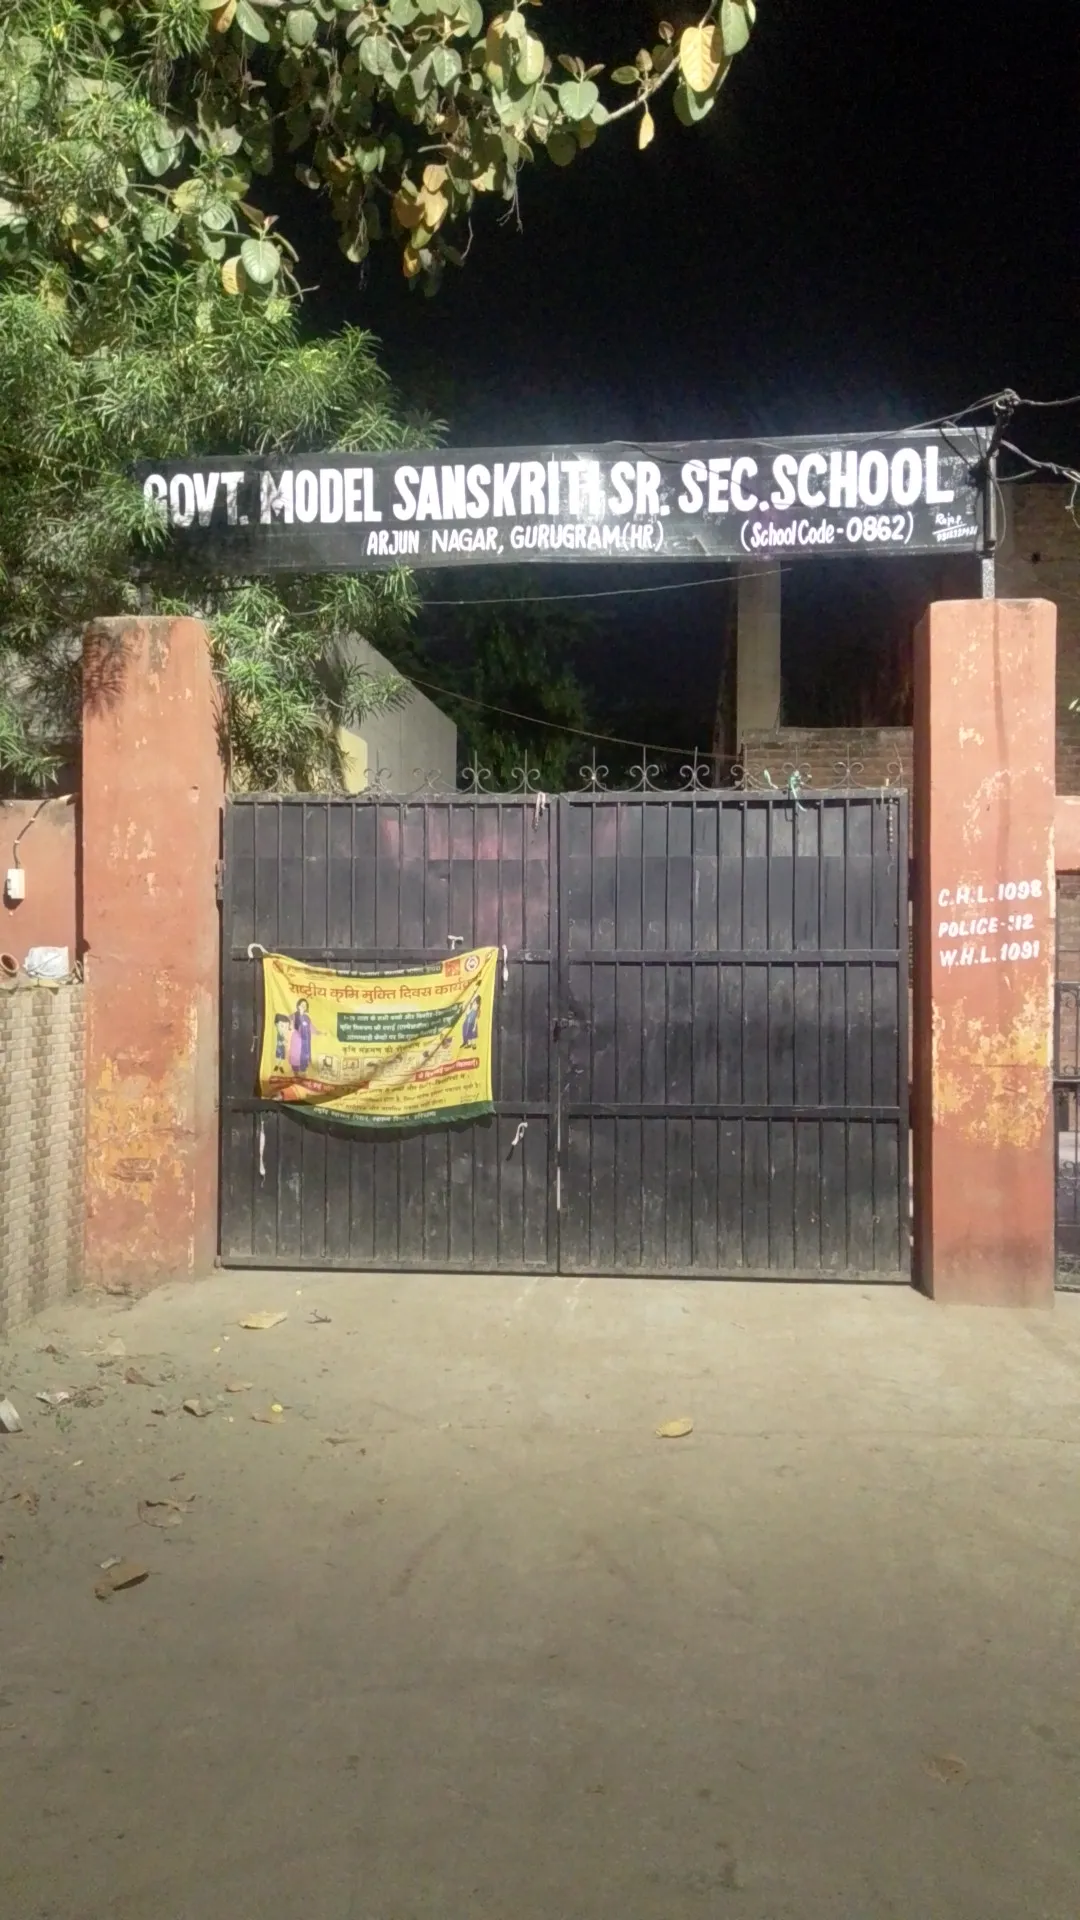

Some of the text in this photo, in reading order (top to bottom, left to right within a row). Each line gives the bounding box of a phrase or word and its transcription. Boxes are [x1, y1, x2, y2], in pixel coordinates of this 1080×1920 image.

[143, 471, 249, 528] GOVT.
[260, 467, 382, 525] MODEL
[392, 460, 602, 522] SANSKRITI
[608, 460, 671, 516] SR.
[367, 529, 419, 556] ARJUN
[431, 526, 505, 555] NAGAR,
[998, 879, 1042, 901] 1098
[1000, 940, 1040, 961] 1091
[289, 982, 327, 999] राष्ट्रीय
[330, 985, 359, 1003] कृमि
[361, 986, 396, 1004] मुक्ति
[400, 984, 433, 999] दिवस
